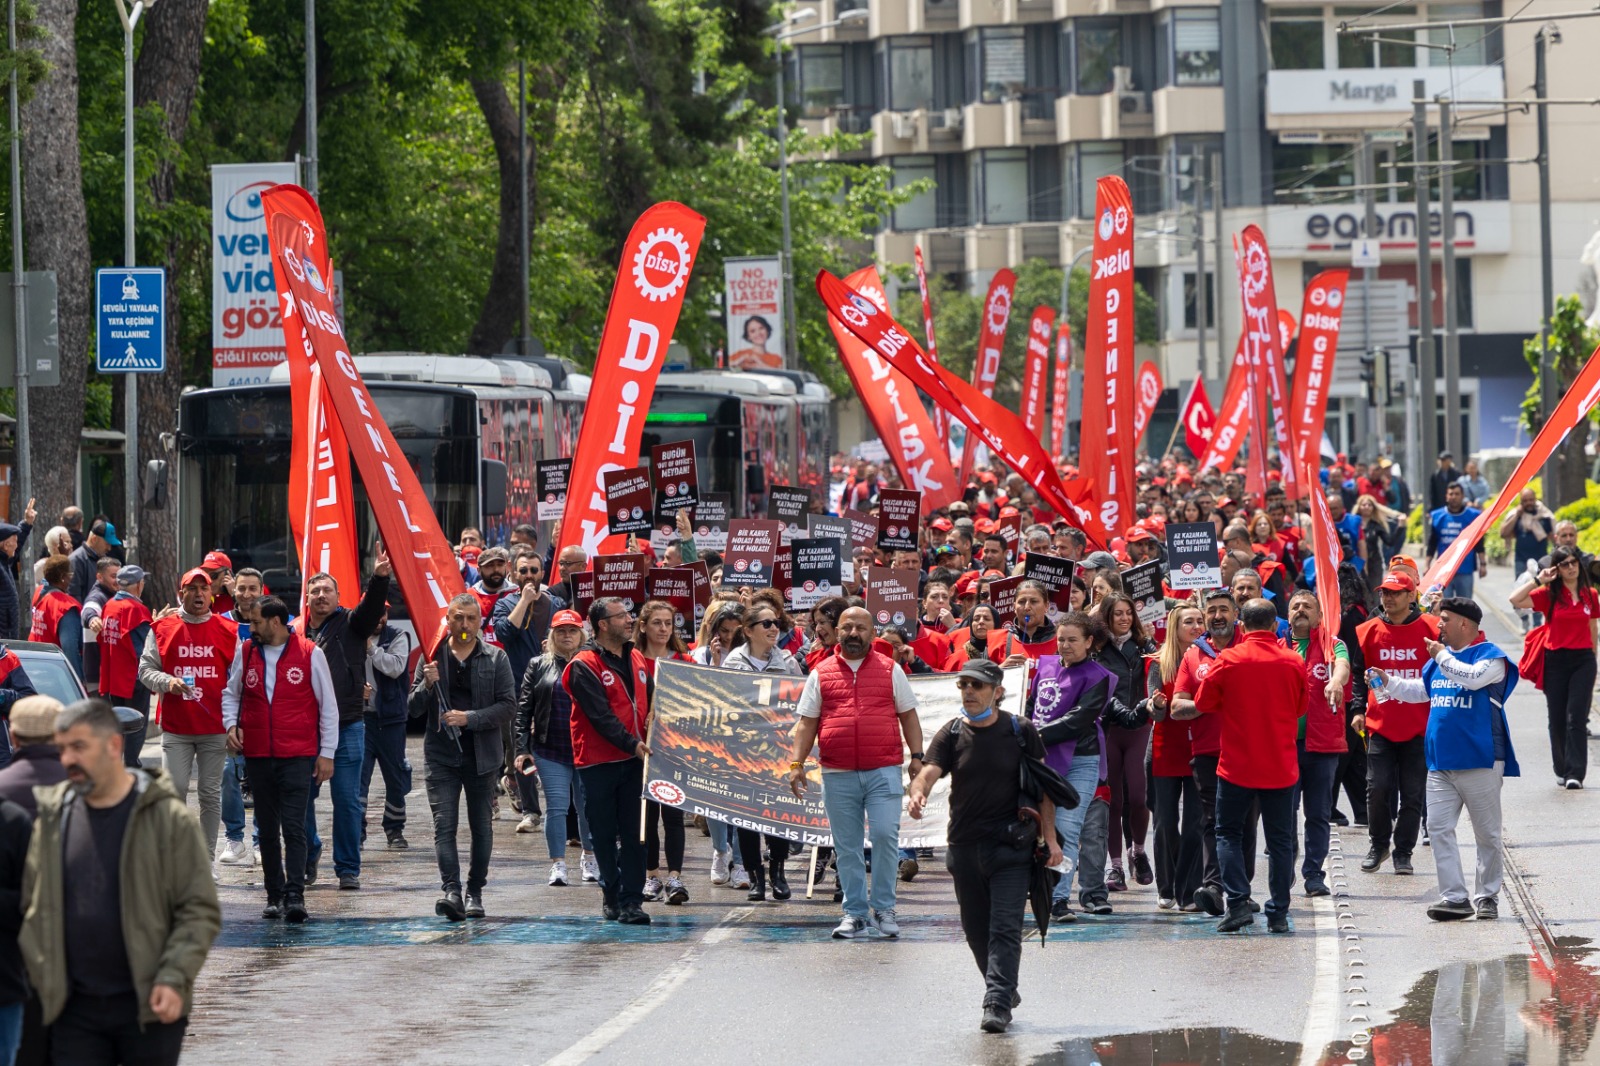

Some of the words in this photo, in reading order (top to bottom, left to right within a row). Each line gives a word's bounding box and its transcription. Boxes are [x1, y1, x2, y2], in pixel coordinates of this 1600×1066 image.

[1329, 80, 1397, 103] Marga
[645, 250, 680, 275] DİSK
[742, 267, 764, 279] NO
[729, 278, 779, 290] TOUCH
[733, 290, 775, 302] LASER
[102, 303, 127, 313] SEVGİLİ
[128, 304, 159, 314] YAYALAR;
[107, 317, 124, 326] YAYA
[125, 316, 154, 328] GEÇİDİNİ
[1303, 312, 1340, 332] DİSK
[111, 330, 151, 339] KULLANINIZ
[877, 326, 910, 358] DİS
[215, 351, 246, 367] ÇİĞLİ
[1299, 335, 1328, 478] GENEL-İ
[662, 447, 687, 460] BUGÜN
[661, 466, 690, 478] MEYDAN!
[335, 350, 450, 609] GENEL-İ
[604, 560, 634, 573] BUGÜN
[602, 580, 638, 591] MEYDAN!
[178, 643, 214, 658] DİSK
[1379, 646, 1418, 660] DİSK
[753, 678, 773, 707] 1
[718, 783, 729, 791] VE
[733, 792, 750, 801] İÇİN
[776, 795, 807, 806] ADALET
[693, 805, 729, 823] DİSK
[732, 815, 799, 840] GENEL-İŞ
